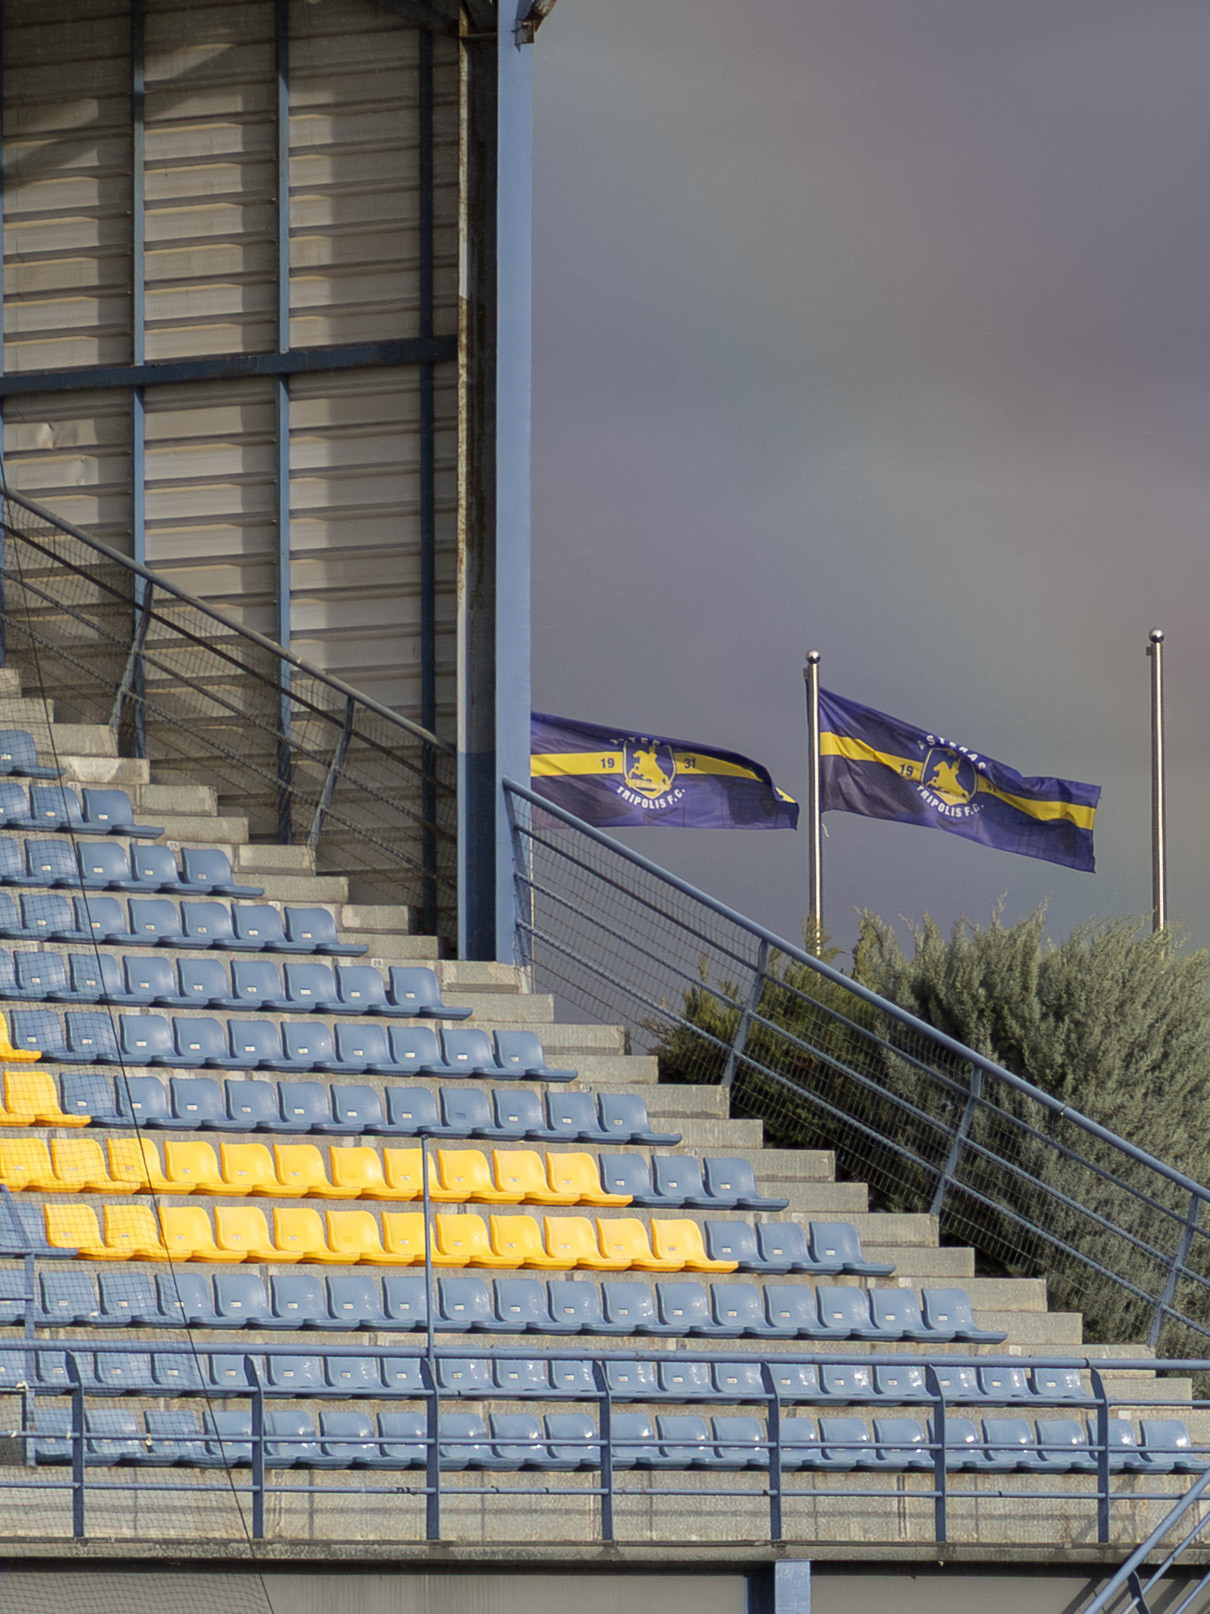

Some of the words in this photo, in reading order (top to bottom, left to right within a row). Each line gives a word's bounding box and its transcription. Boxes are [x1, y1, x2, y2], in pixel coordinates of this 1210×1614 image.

[601, 757, 615, 769] 19
[684, 758, 697, 769] 31
[899, 763, 914, 778] 19
[616, 786, 667, 810] TRIPOLIS
[667, 789, 686, 806] F.C.
[917, 785, 963, 818] TRIPOLIS
[963, 803, 985, 817] F.C.
